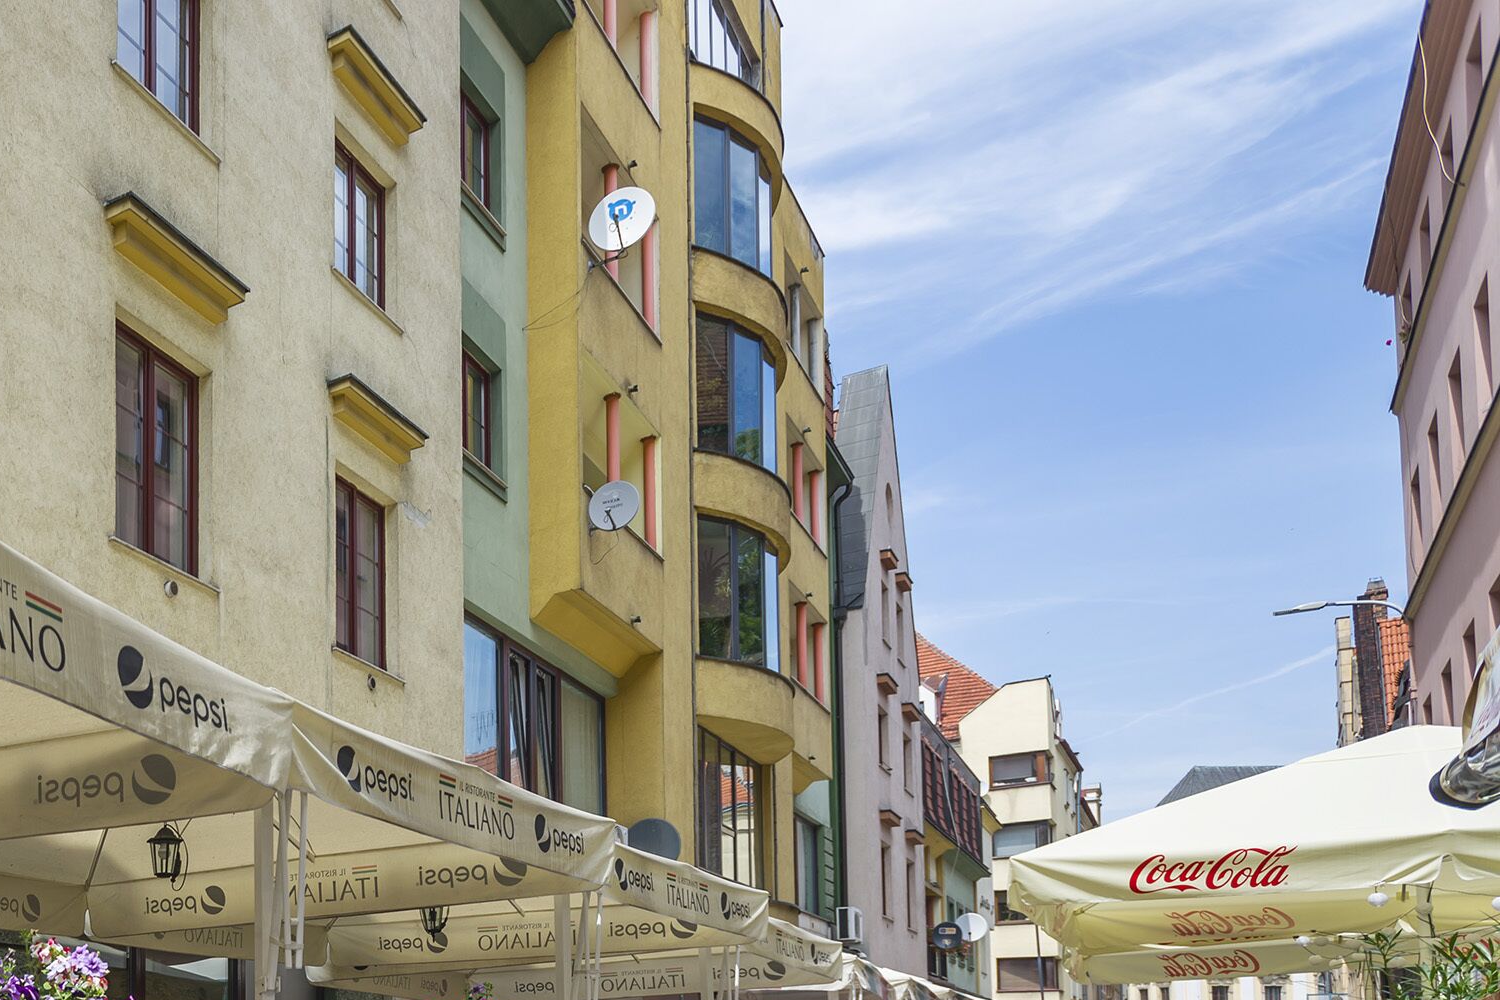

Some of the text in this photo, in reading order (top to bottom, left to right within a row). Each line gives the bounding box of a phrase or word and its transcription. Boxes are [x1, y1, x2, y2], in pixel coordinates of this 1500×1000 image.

[160, 676, 229, 732] pepsi
[365, 765, 413, 801] pepsi
[465, 783, 496, 801] RISTORANTE
[439, 789, 515, 840] ITALIANO
[553, 828, 585, 855] pepsi
[628, 870, 655, 893] pepsi
[1129, 845, 1298, 895] Coca-Cola
[667, 884, 710, 915] ITALIANO
[731, 901, 751, 919] pepsi
